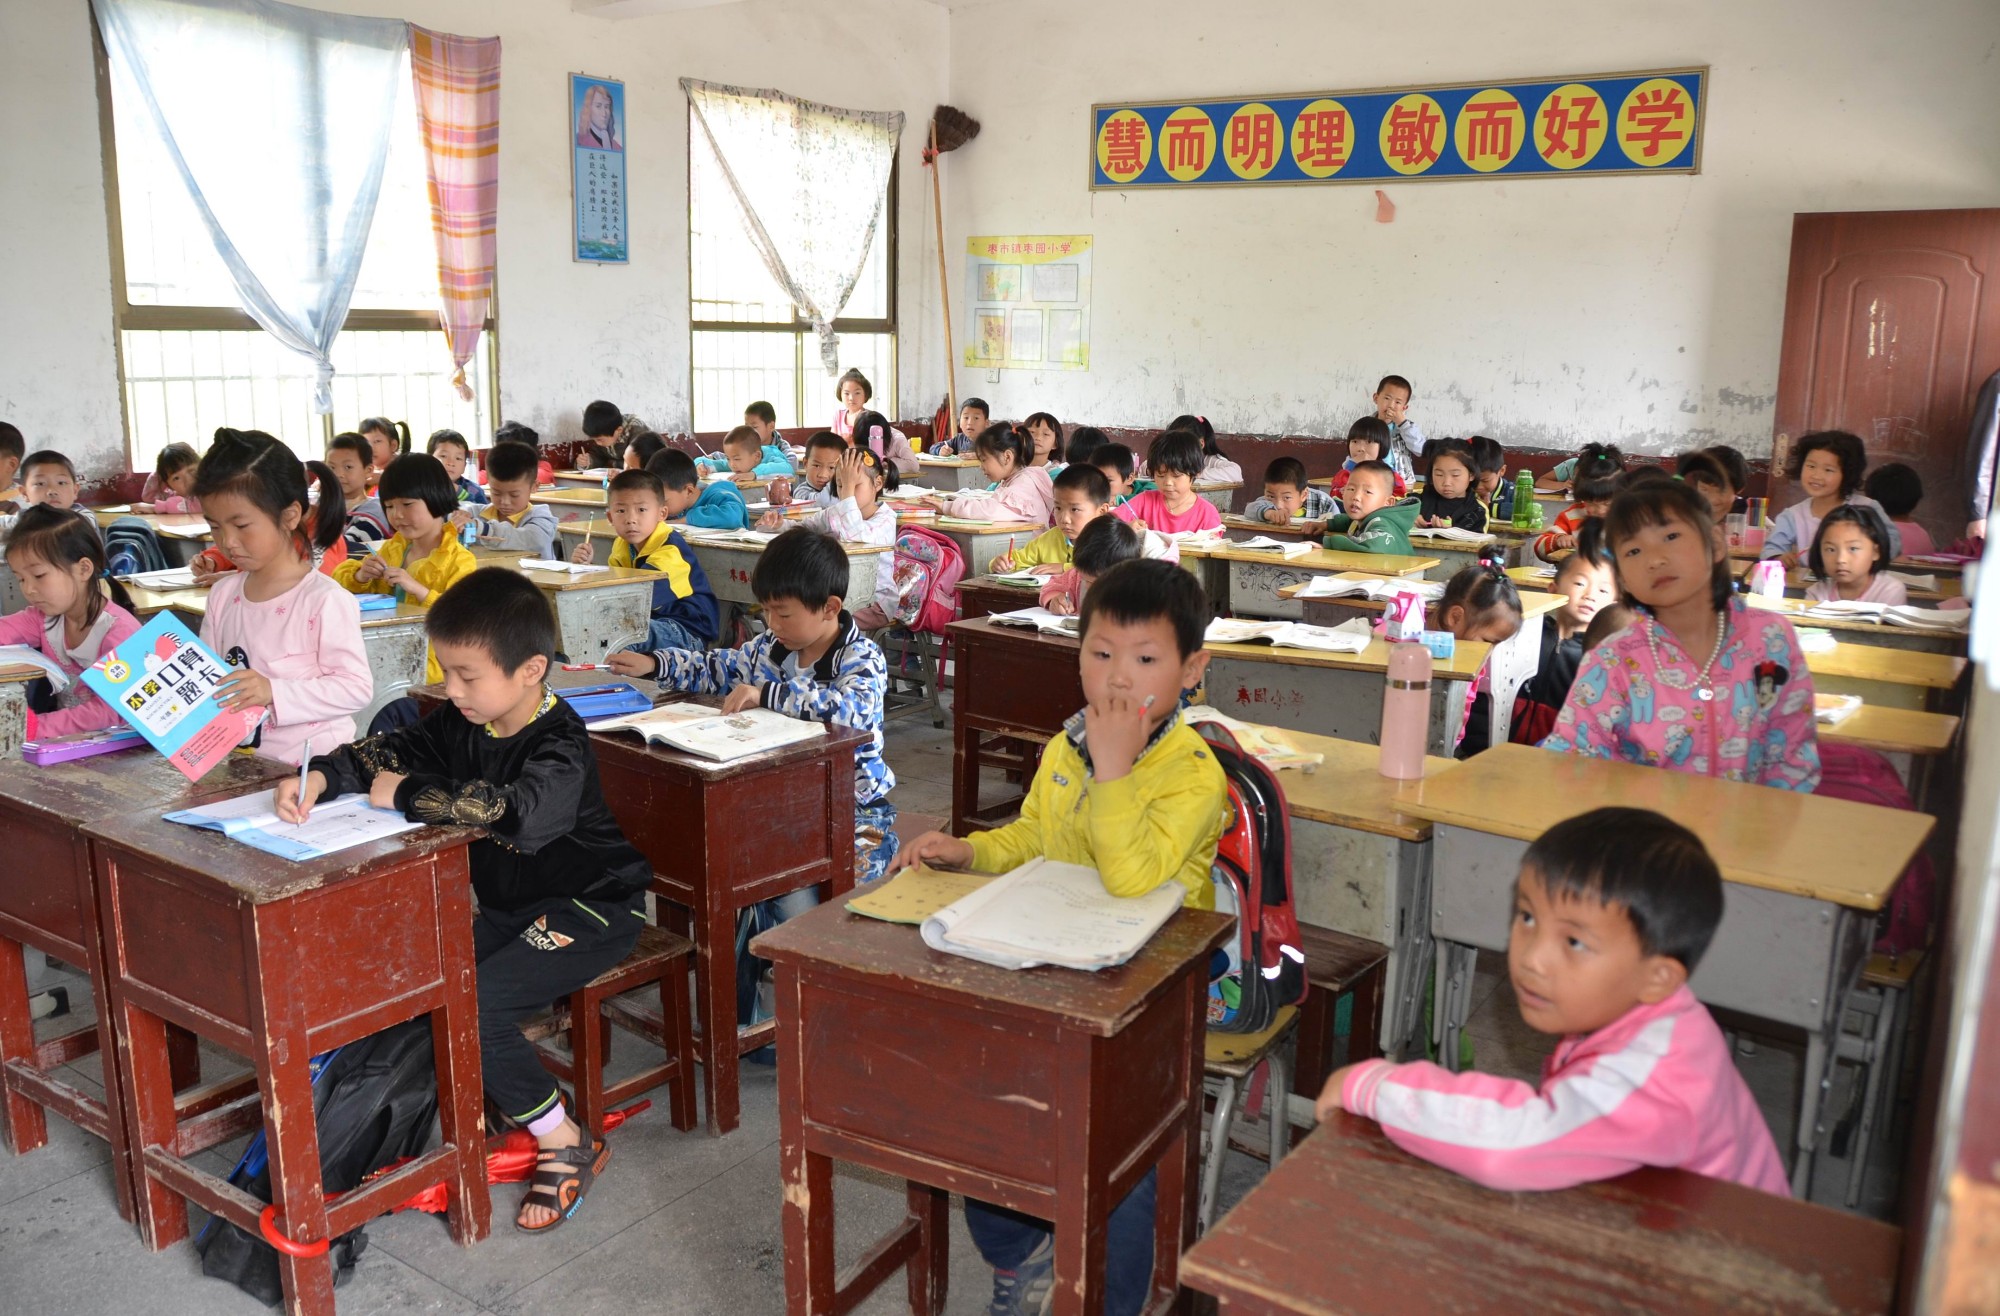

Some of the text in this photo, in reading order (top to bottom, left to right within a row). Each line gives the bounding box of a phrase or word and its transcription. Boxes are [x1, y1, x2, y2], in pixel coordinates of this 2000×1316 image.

[1104, 89, 1685, 174] 慧而明理 敏而好学
